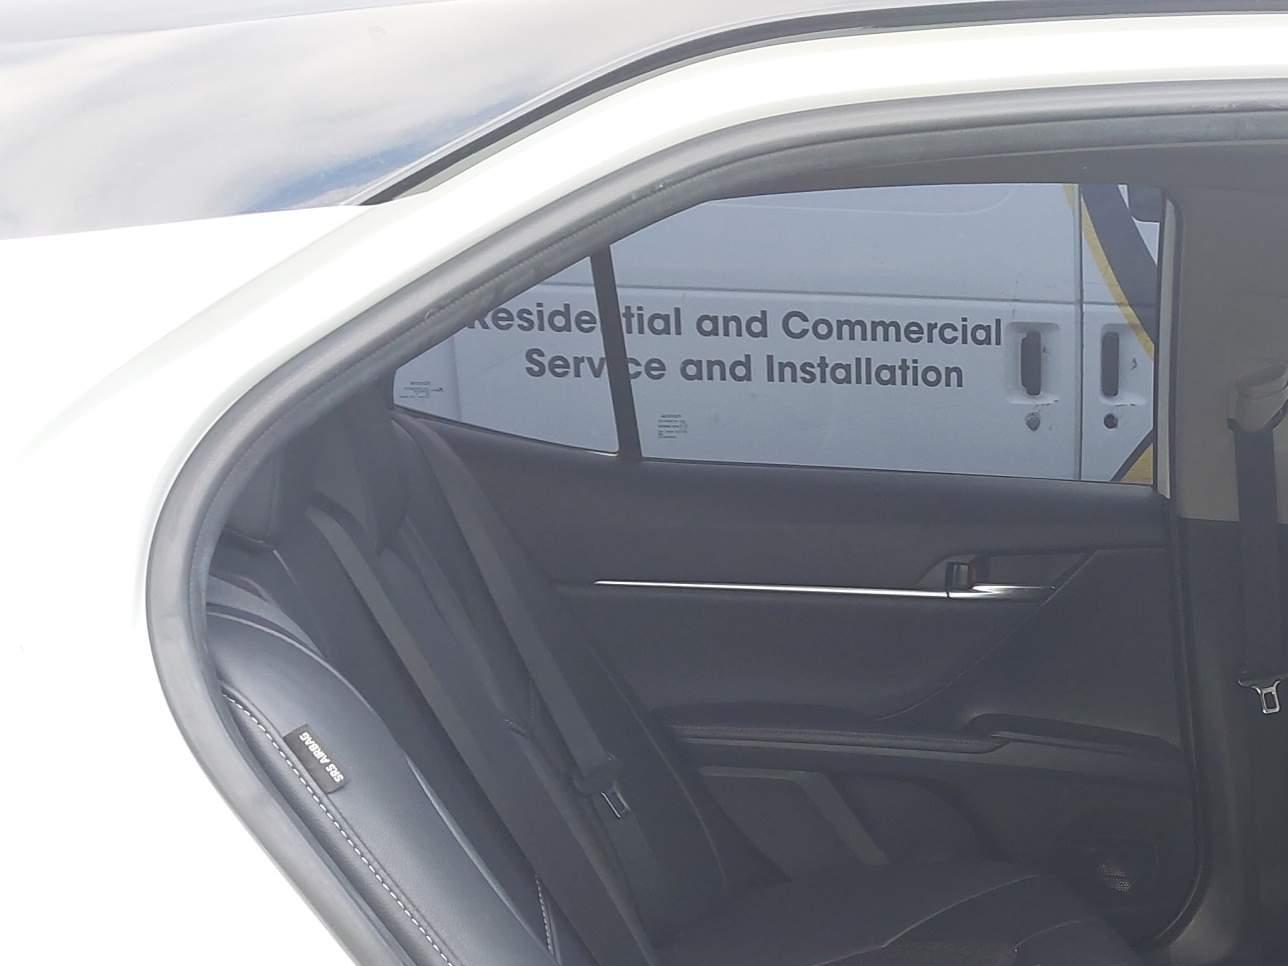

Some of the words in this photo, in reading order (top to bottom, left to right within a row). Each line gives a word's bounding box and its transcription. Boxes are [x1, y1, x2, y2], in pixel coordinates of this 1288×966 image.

[467, 302, 682, 336] esidetial
[696, 310, 768, 338] and
[782, 310, 1001, 346] Commercial
[525, 347, 666, 380] Servce
[680, 354, 752, 382] and
[766, 354, 963, 388] Installation
[298, 731, 331, 764] AIRBAG
[325, 763, 344, 783] SRS
